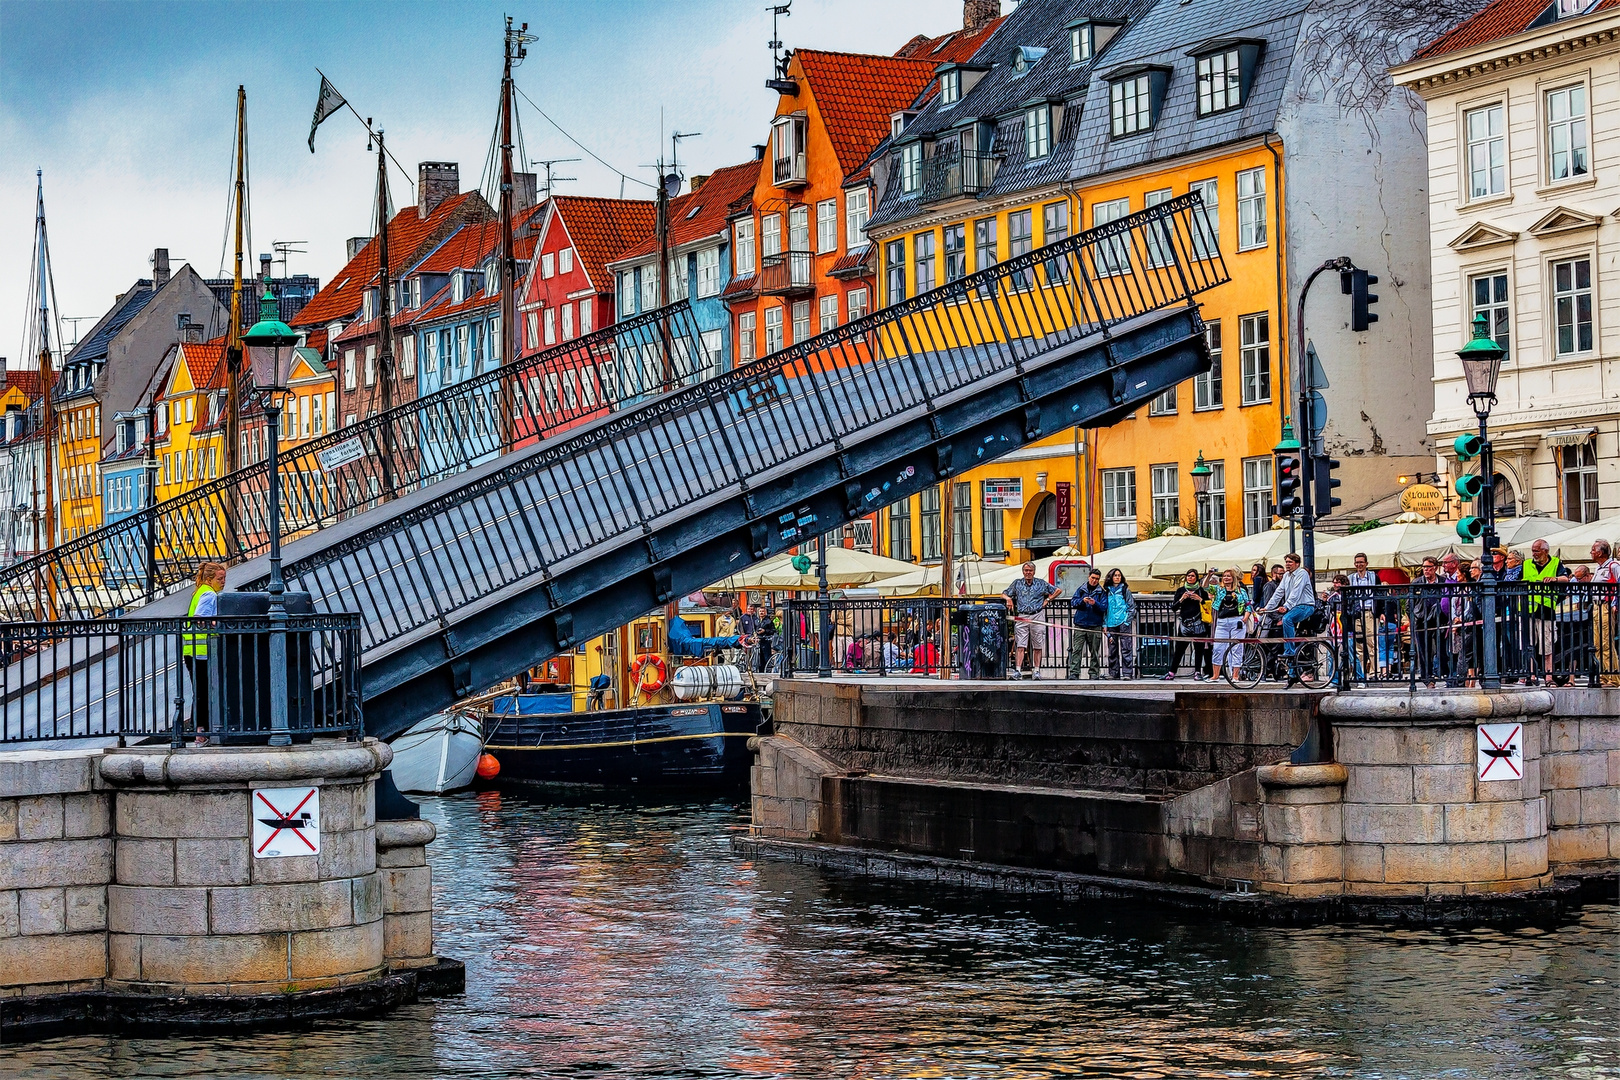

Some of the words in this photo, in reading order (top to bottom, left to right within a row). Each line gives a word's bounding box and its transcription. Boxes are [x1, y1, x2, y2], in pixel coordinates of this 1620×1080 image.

[1556, 436, 1580, 444] ITALIAN
[1412, 491, 1439, 499] L'OLIVO
[1059, 488, 1068, 525] マリリア
